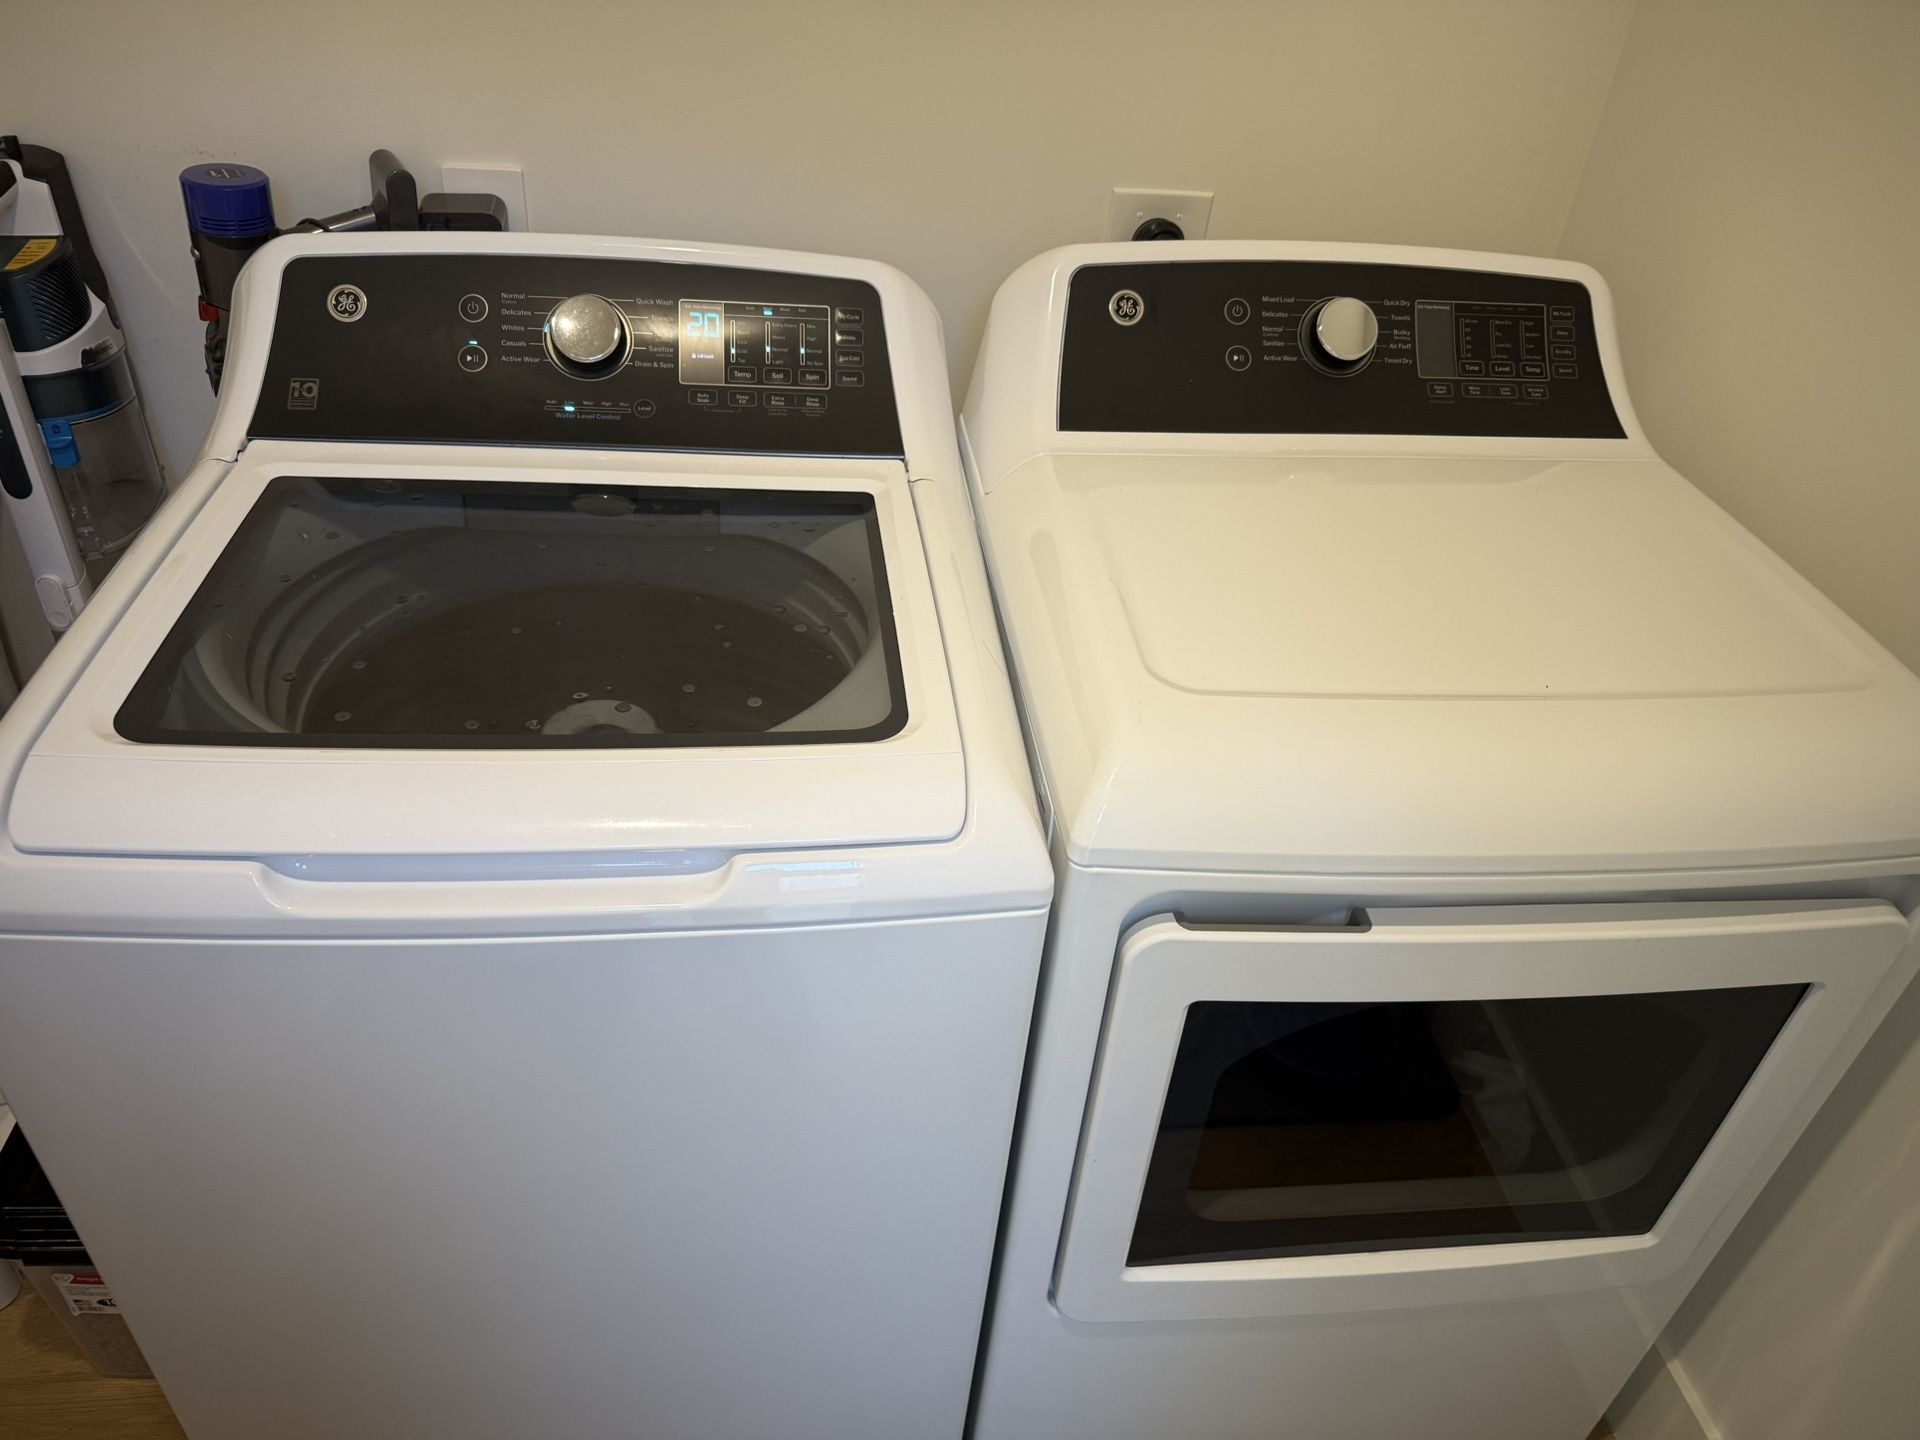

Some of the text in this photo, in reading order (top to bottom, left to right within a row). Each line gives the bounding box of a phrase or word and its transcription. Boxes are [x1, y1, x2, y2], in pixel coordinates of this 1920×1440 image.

[501, 308, 532, 316] Delicates
[687, 311, 720, 338] 20
[501, 339, 527, 347] Casuals
[648, 345, 674, 353] Sanitize
[501, 355, 541, 363] Active Wear
[659, 361, 674, 369] Spin
[805, 373, 820, 381] Spin
[595, 413, 621, 421] Control
